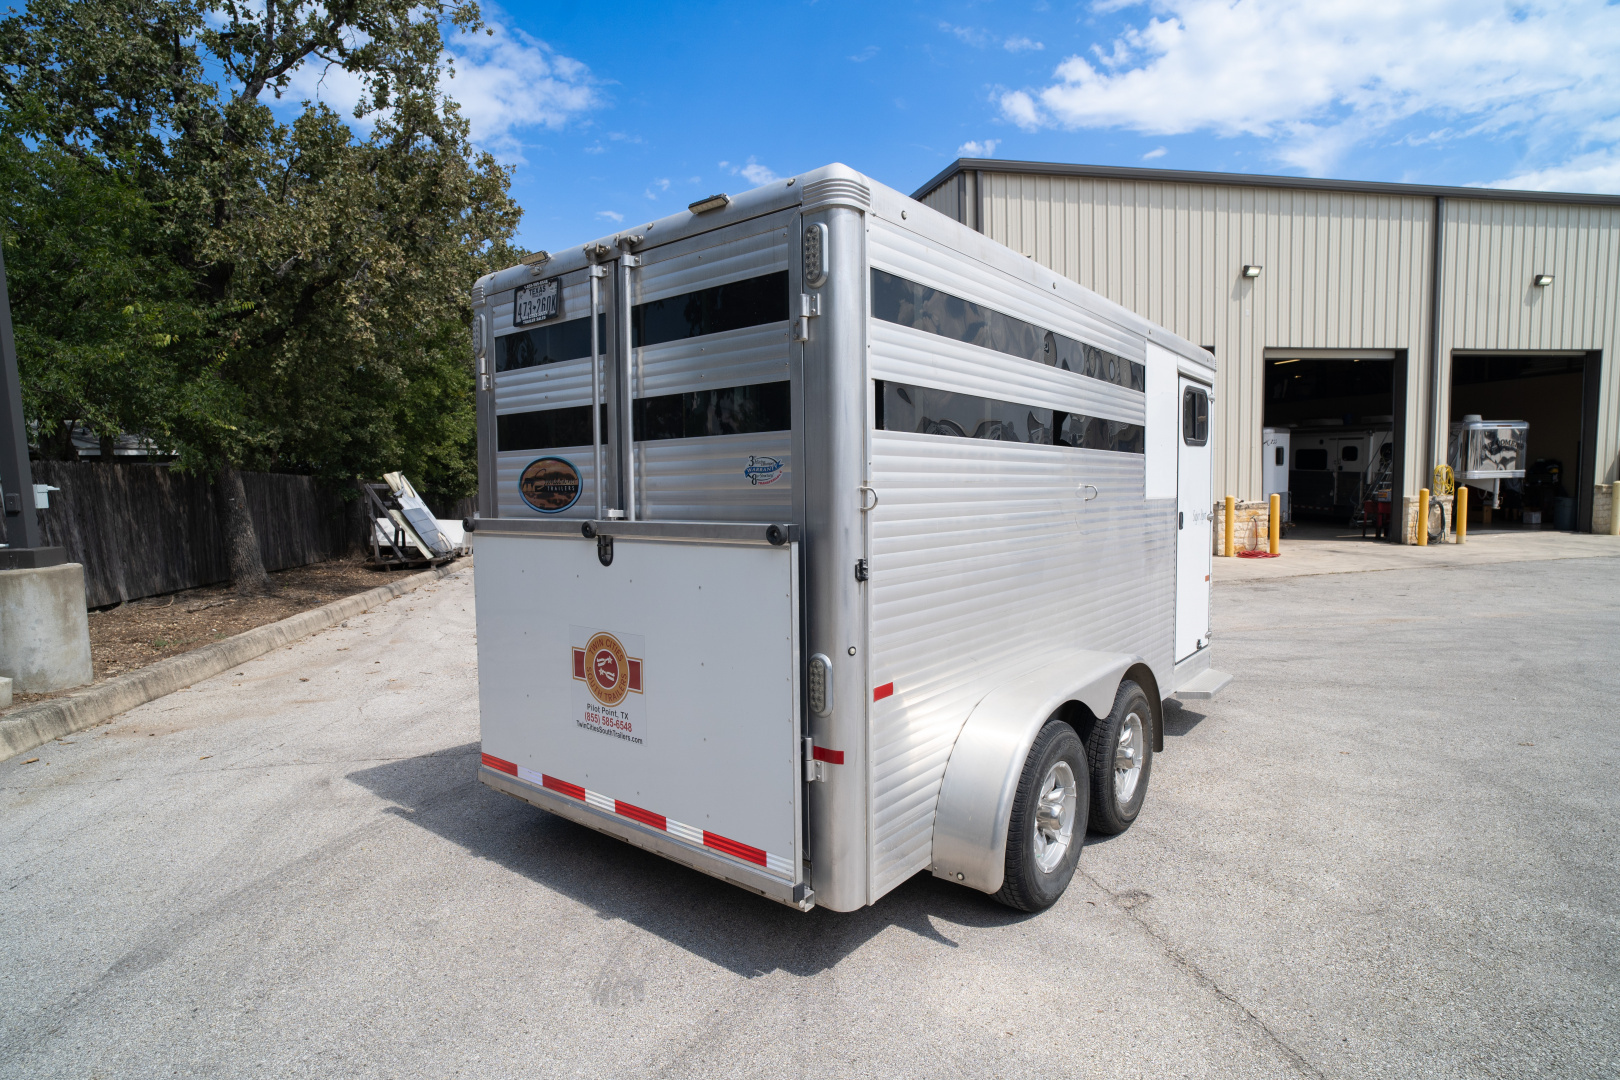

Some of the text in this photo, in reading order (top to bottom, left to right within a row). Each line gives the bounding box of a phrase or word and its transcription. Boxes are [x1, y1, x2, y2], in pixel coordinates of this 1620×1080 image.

[529, 285, 546, 296] TEXAS
[747, 463, 778, 473] WARRANTY
[588, 638, 624, 662] TWIN CITIES
[586, 666, 628, 702] SOUTH TRAILERS
[584, 711, 633, 733] (855) 585-6548
[586, 703, 601, 714] Pilot
[620, 711, 629, 720] TX
[576, 719, 643, 745] TwinCitiesSouthTrailers.com
